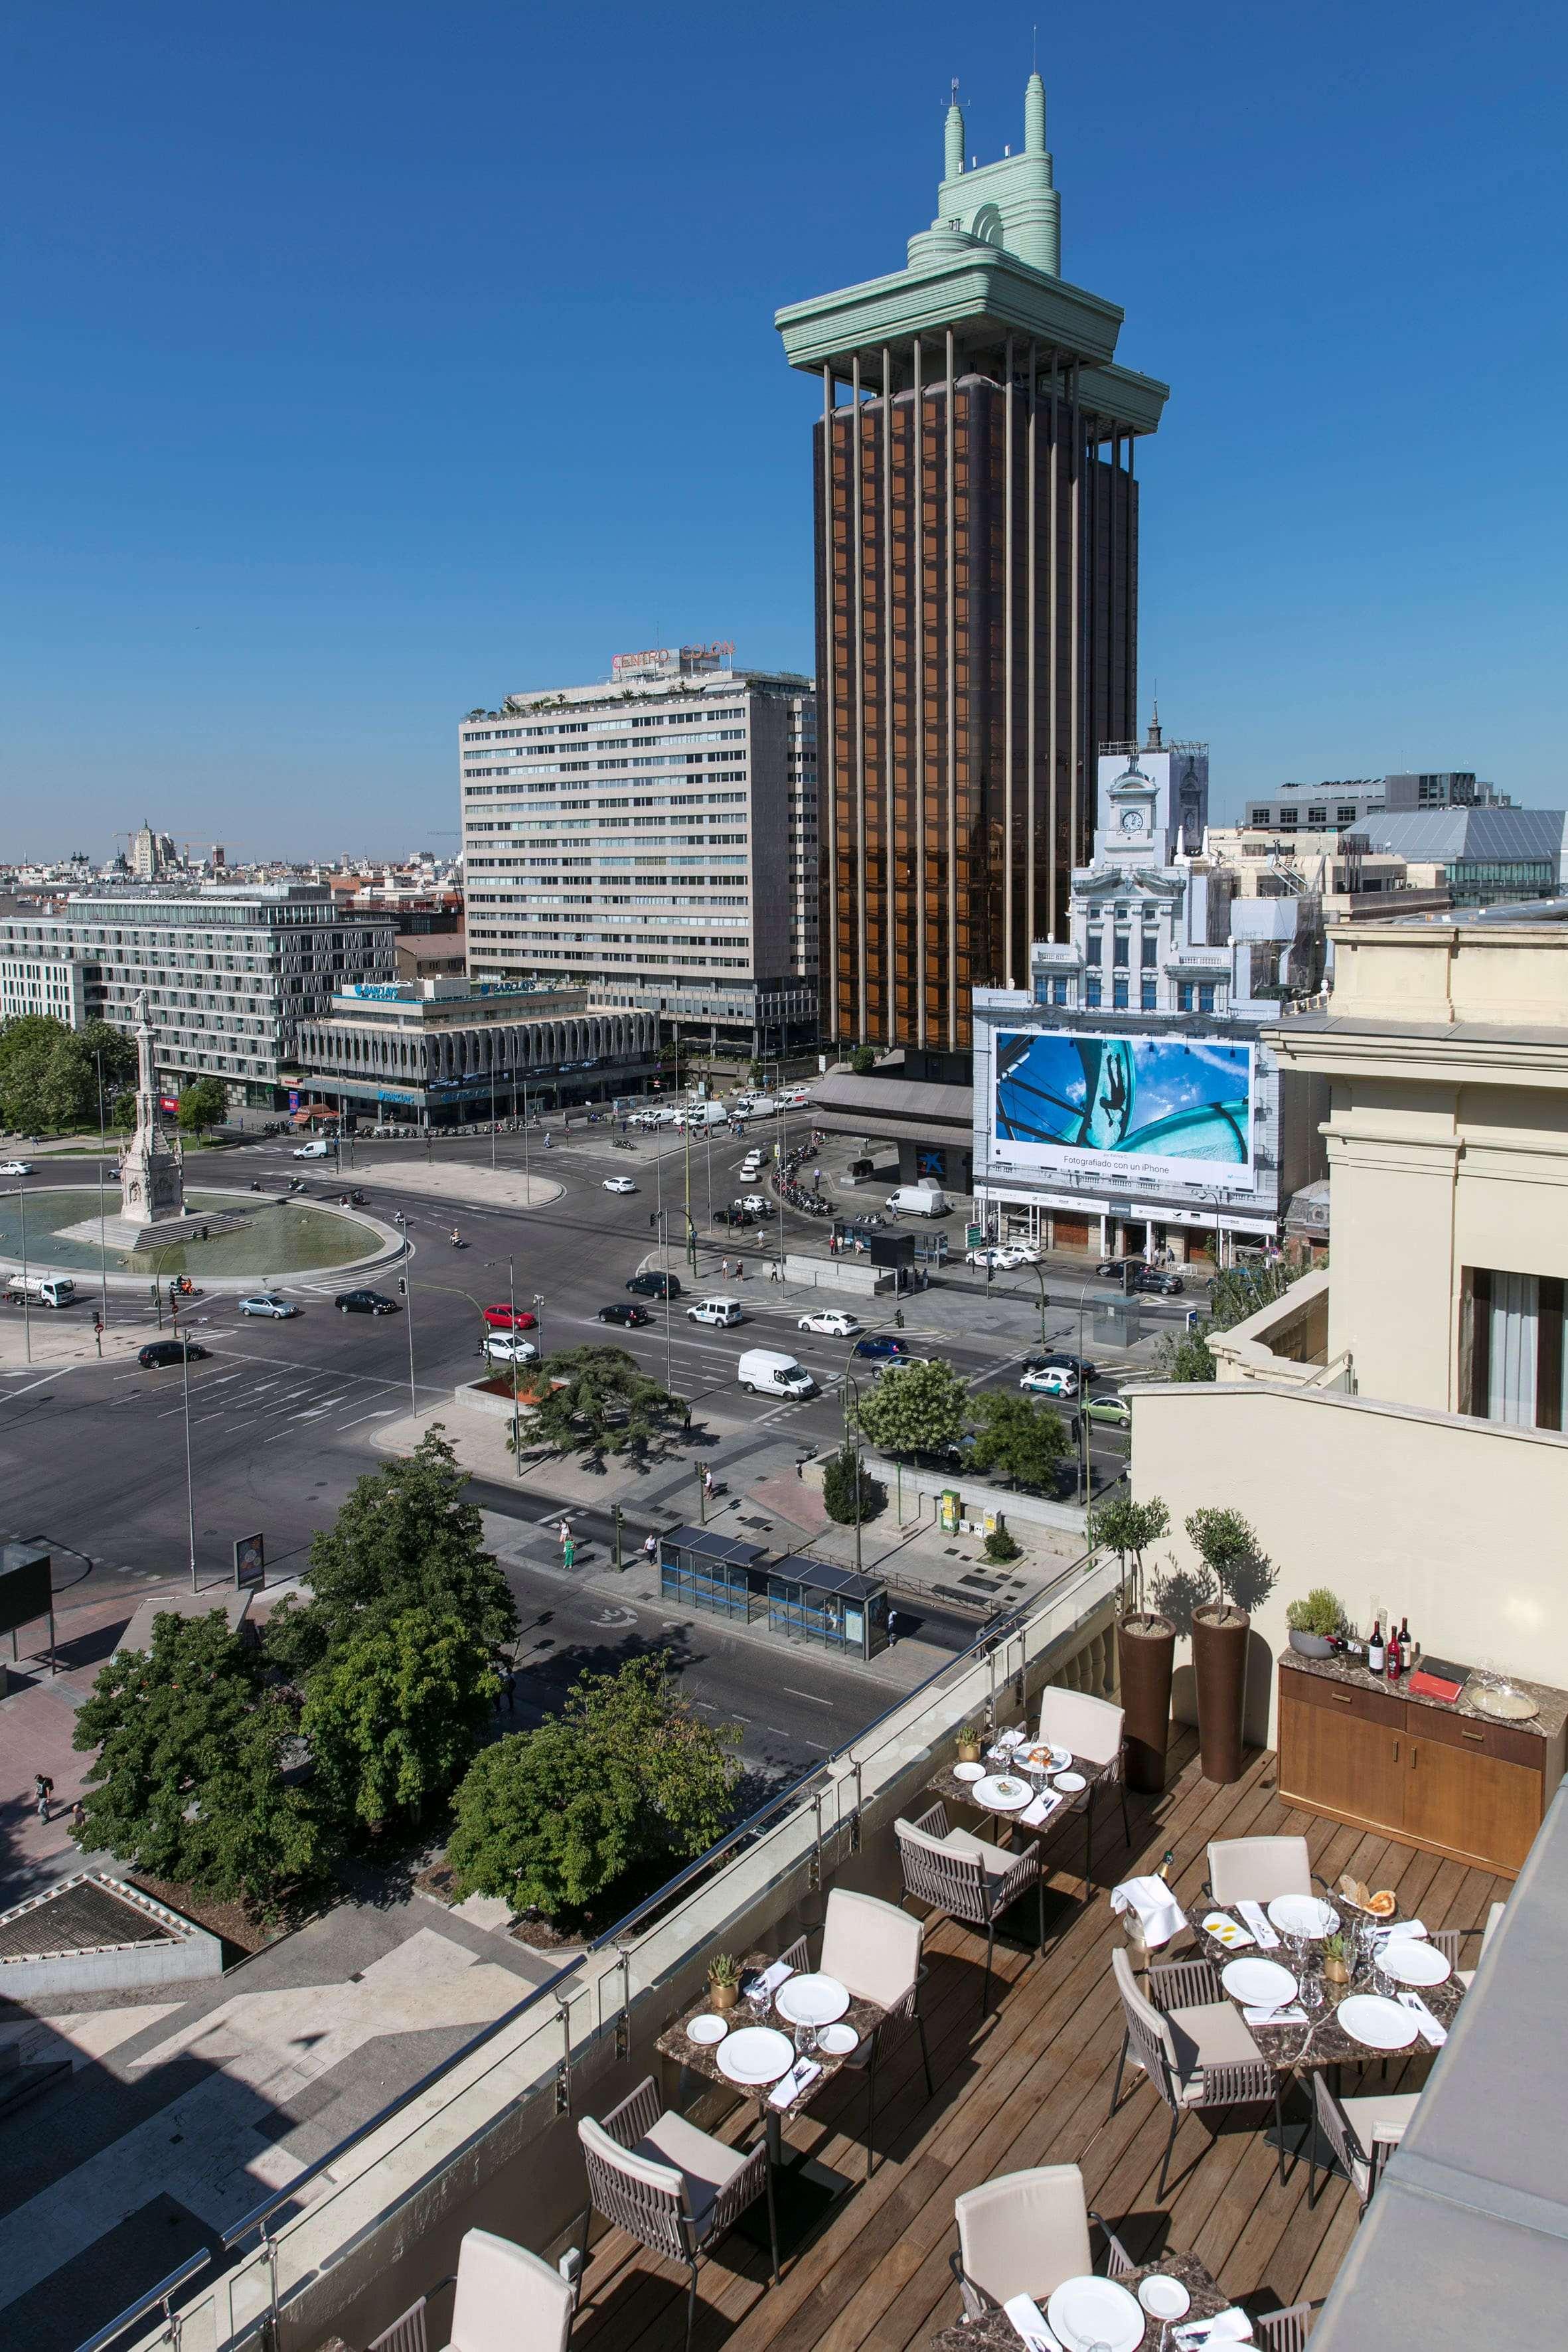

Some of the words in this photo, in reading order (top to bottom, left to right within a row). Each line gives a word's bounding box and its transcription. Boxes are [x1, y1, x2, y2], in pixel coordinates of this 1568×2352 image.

[612, 649, 669, 669] CENTRO
[363, 985, 398, 998] BARCLAYS
[493, 980, 536, 992] BARCLAYS
[384, 1091, 414, 1105] BARCLAYS
[1063, 1155, 1112, 1168] Fotografiado
[1142, 1164, 1170, 1174] iPhone
